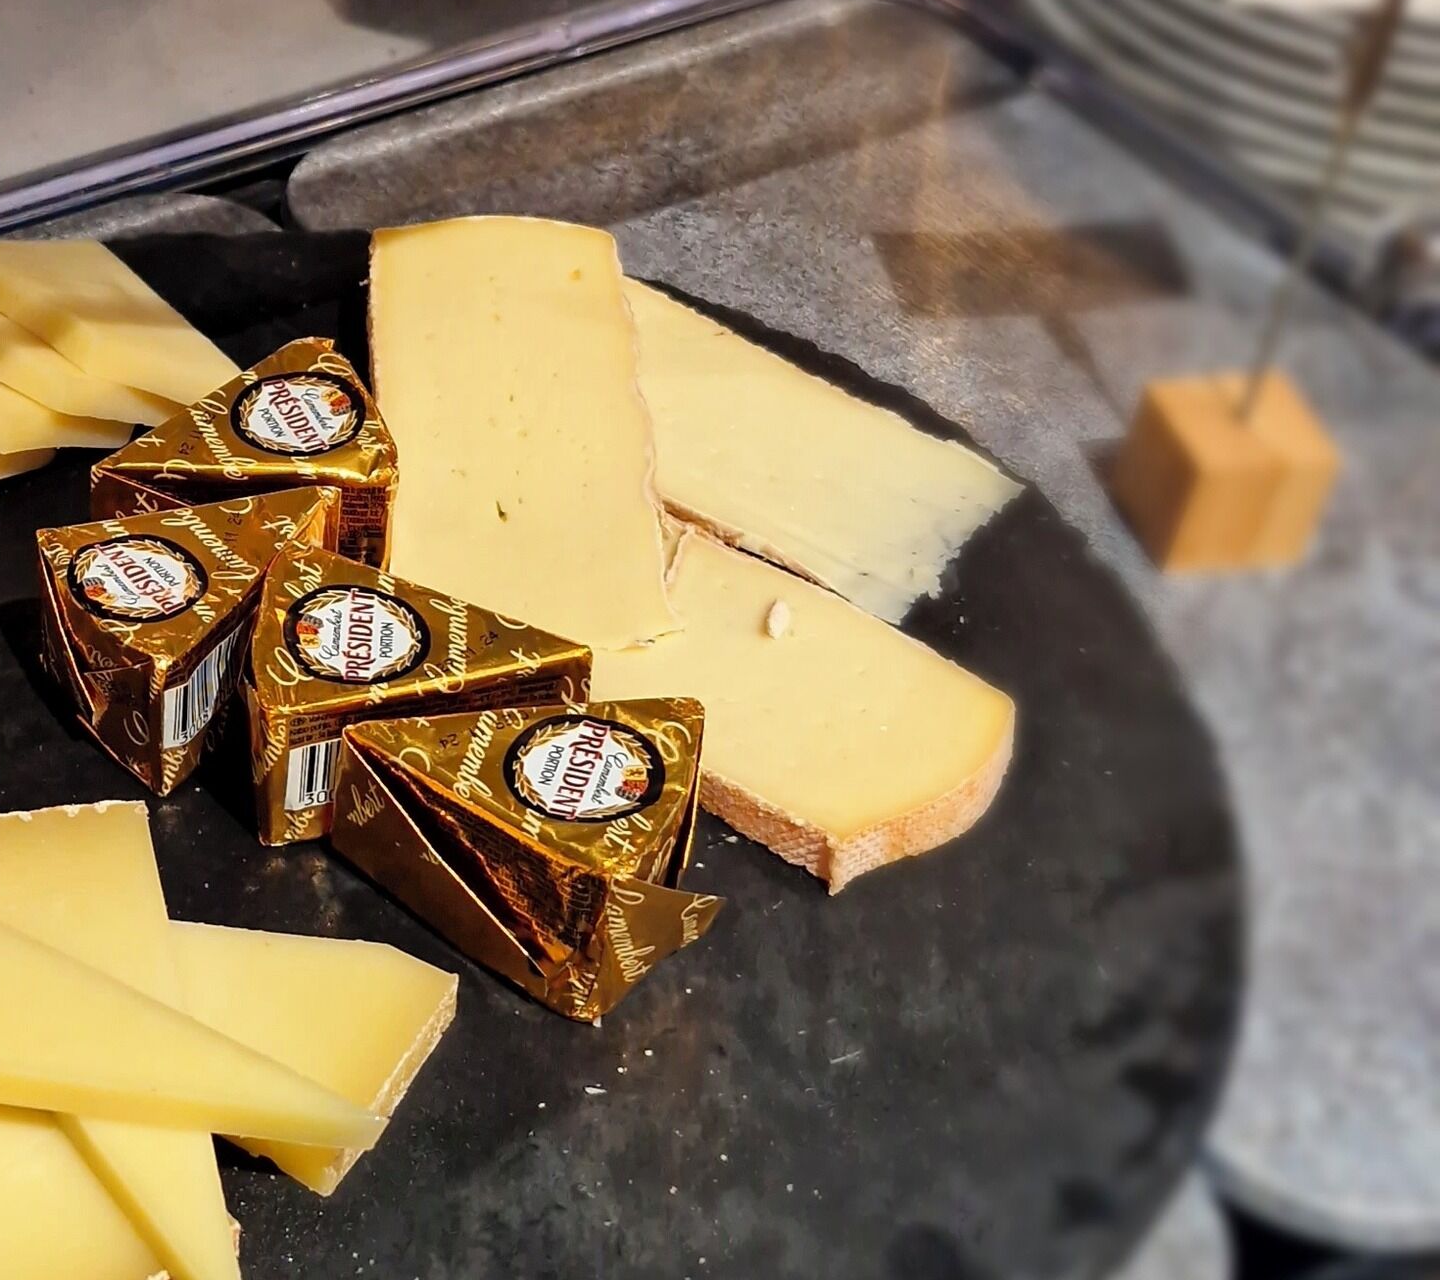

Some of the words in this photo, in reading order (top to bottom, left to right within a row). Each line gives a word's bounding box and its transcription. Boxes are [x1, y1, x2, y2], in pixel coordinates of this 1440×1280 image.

[257, 407, 287, 439] PORTION
[263, 377, 330, 451] PRÉSIDENT
[301, 387, 333, 432] Camembert
[94, 542, 187, 615] PRÉSIDENT
[96, 563, 140, 606] Camembert
[142, 556, 181, 588] PORTION
[319, 608, 344, 662] Camembert
[343, 587, 377, 681] PRÉSIDENT
[378, 621, 395, 660] PORTION
[538, 743, 565, 787] PORTION
[554, 719, 611, 822] PRÉSIDENT
[592, 752, 629, 806] Camembert
